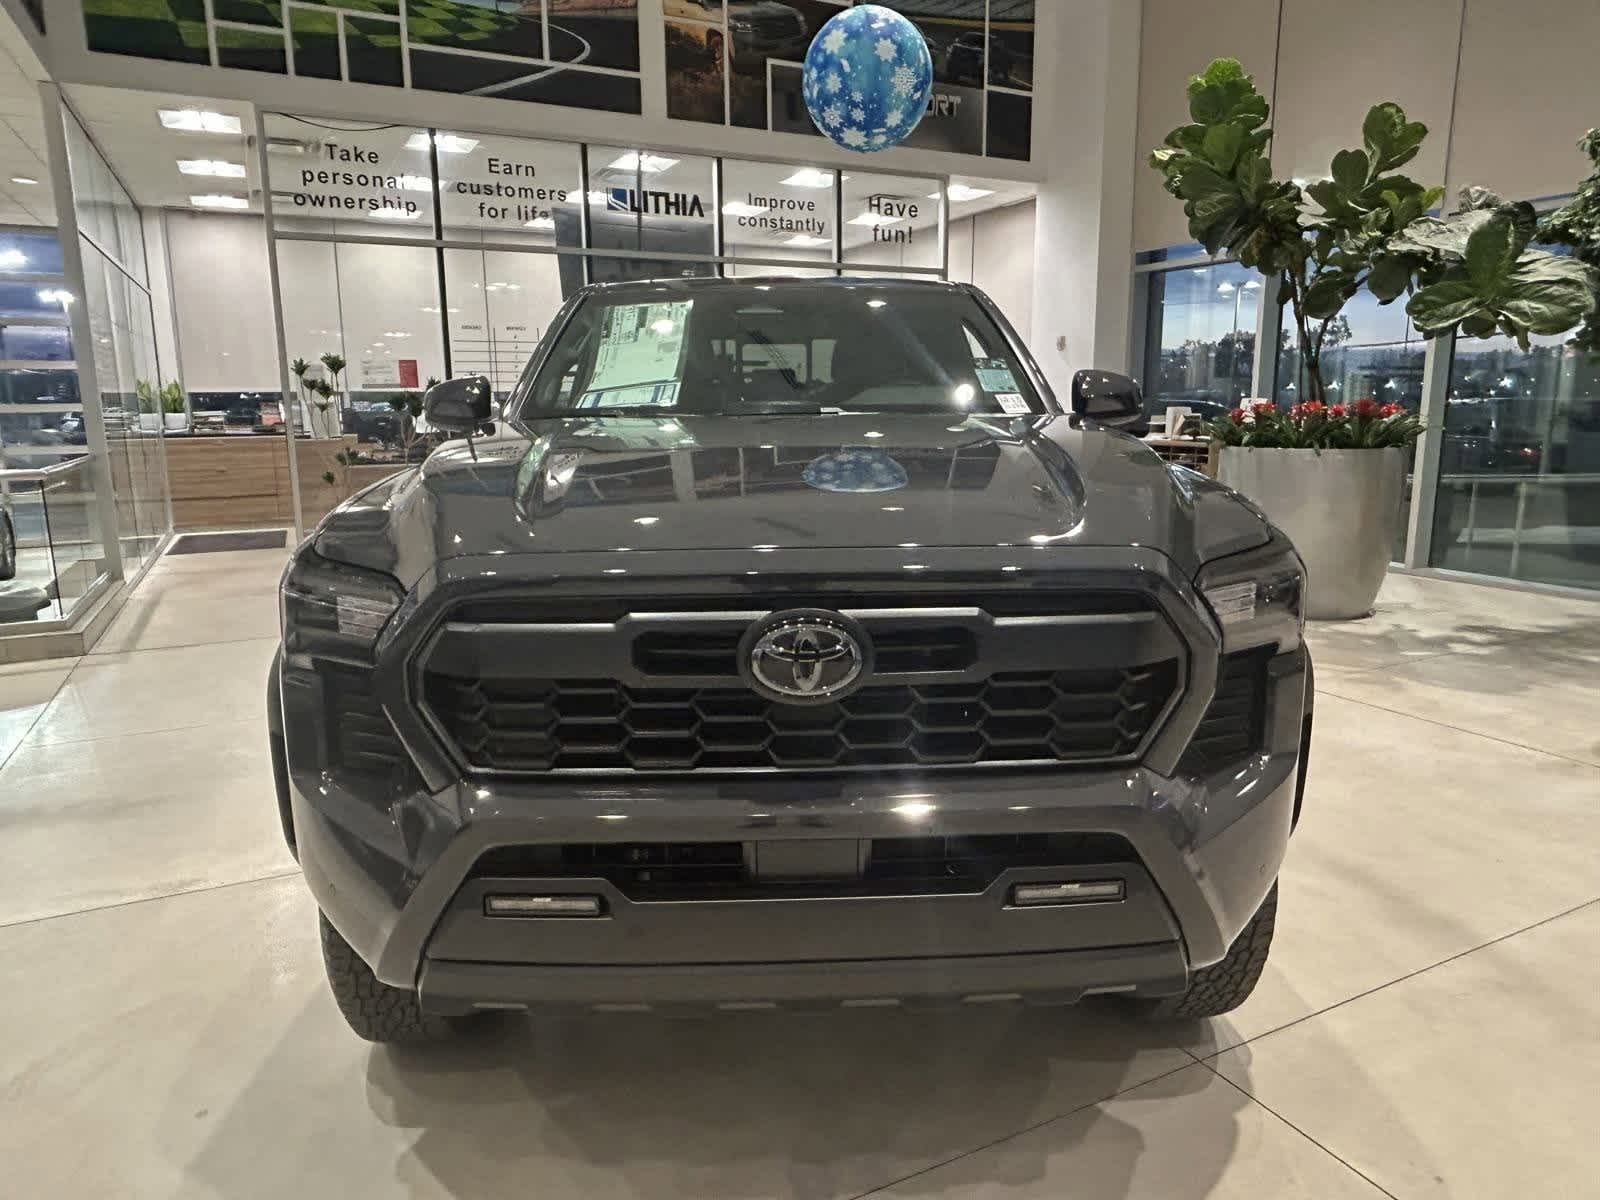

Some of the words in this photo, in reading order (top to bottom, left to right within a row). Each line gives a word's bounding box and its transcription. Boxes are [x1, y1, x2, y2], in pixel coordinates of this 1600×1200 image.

[325, 144, 379, 165] Take
[488, 158, 536, 177] Earn
[456, 180, 568, 202] customers
[293, 193, 418, 216] ownership
[478, 202, 508, 219] for
[517, 205, 549, 221] life
[629, 189, 705, 218] LITHIA
[747, 193, 816, 213] Improve
[868, 196, 919, 218] Have
[737, 214, 826, 235] constantly
[872, 226, 913, 244] fun!
